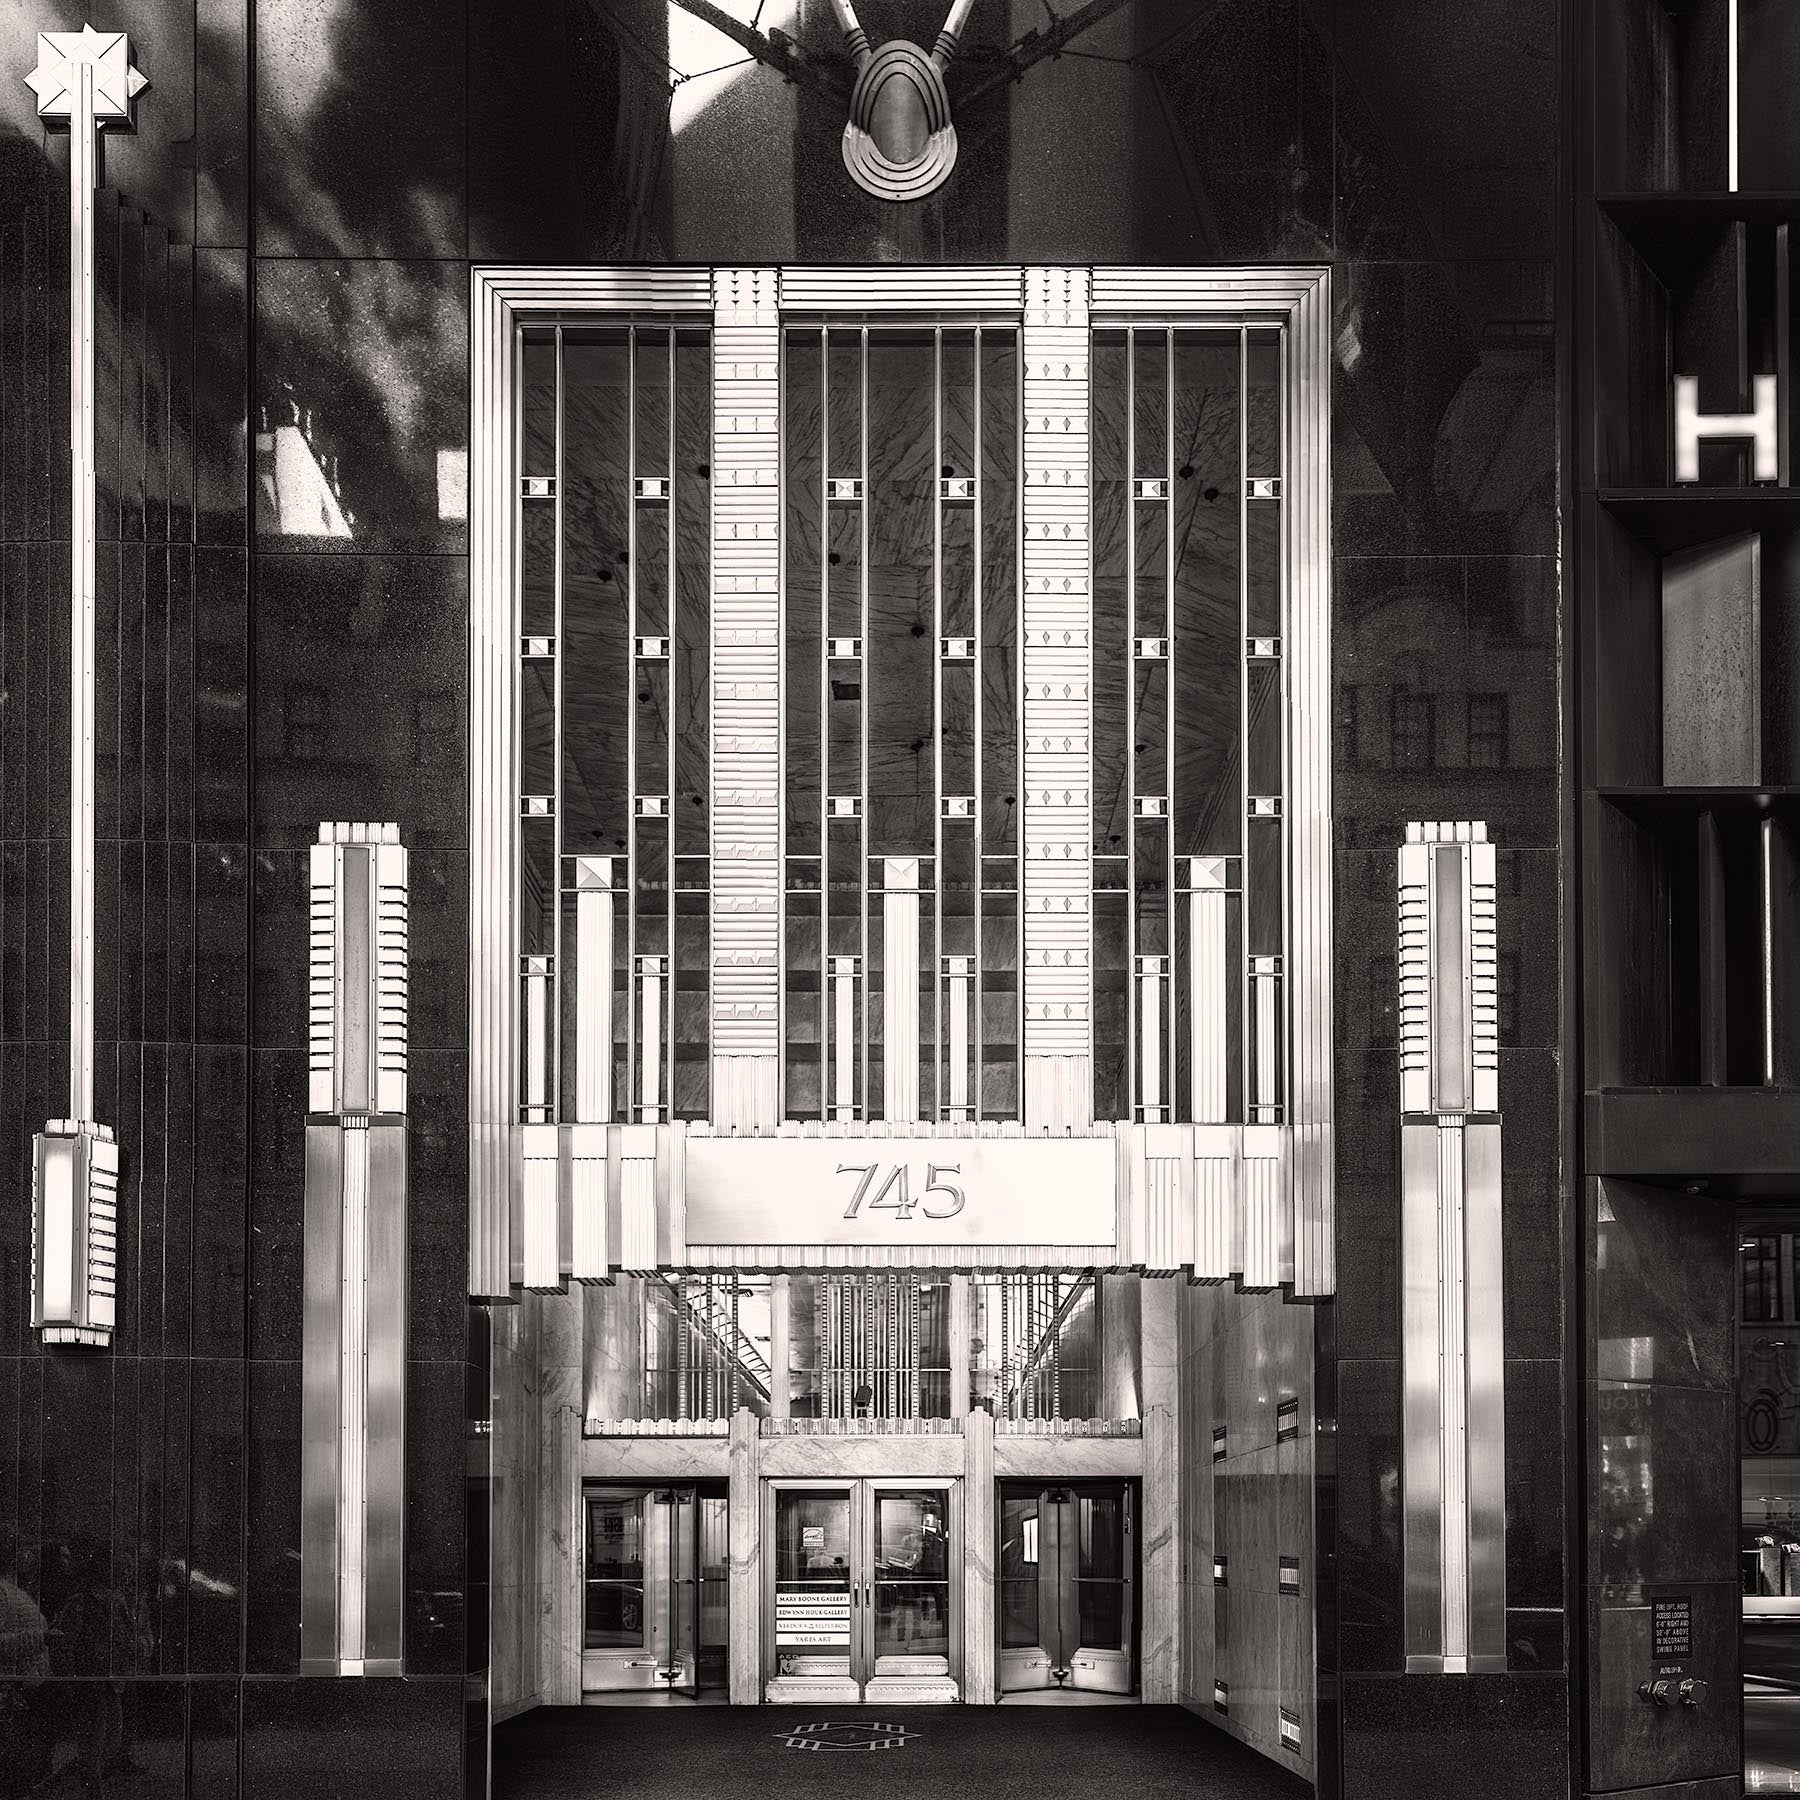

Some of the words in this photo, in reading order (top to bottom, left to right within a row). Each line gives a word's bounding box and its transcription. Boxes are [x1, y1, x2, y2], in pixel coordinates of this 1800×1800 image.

[1673, 374, 1778, 482] H
[836, 1163, 966, 1220] 745
[1656, 1603, 1666, 1611] FIRE
[1672, 1611, 1689, 1619] LOCATED
[1667, 1620, 1680, 1628] RIGHT
[1680, 1619, 1689, 1627] AND
[1672, 1628, 1689, 1636] ABOVE
[1662, 1636, 1689, 1645] DECORATIVE
[1656, 1645, 1673, 1654] SWING
[1673, 1644, 1689, 1653] PANEL
